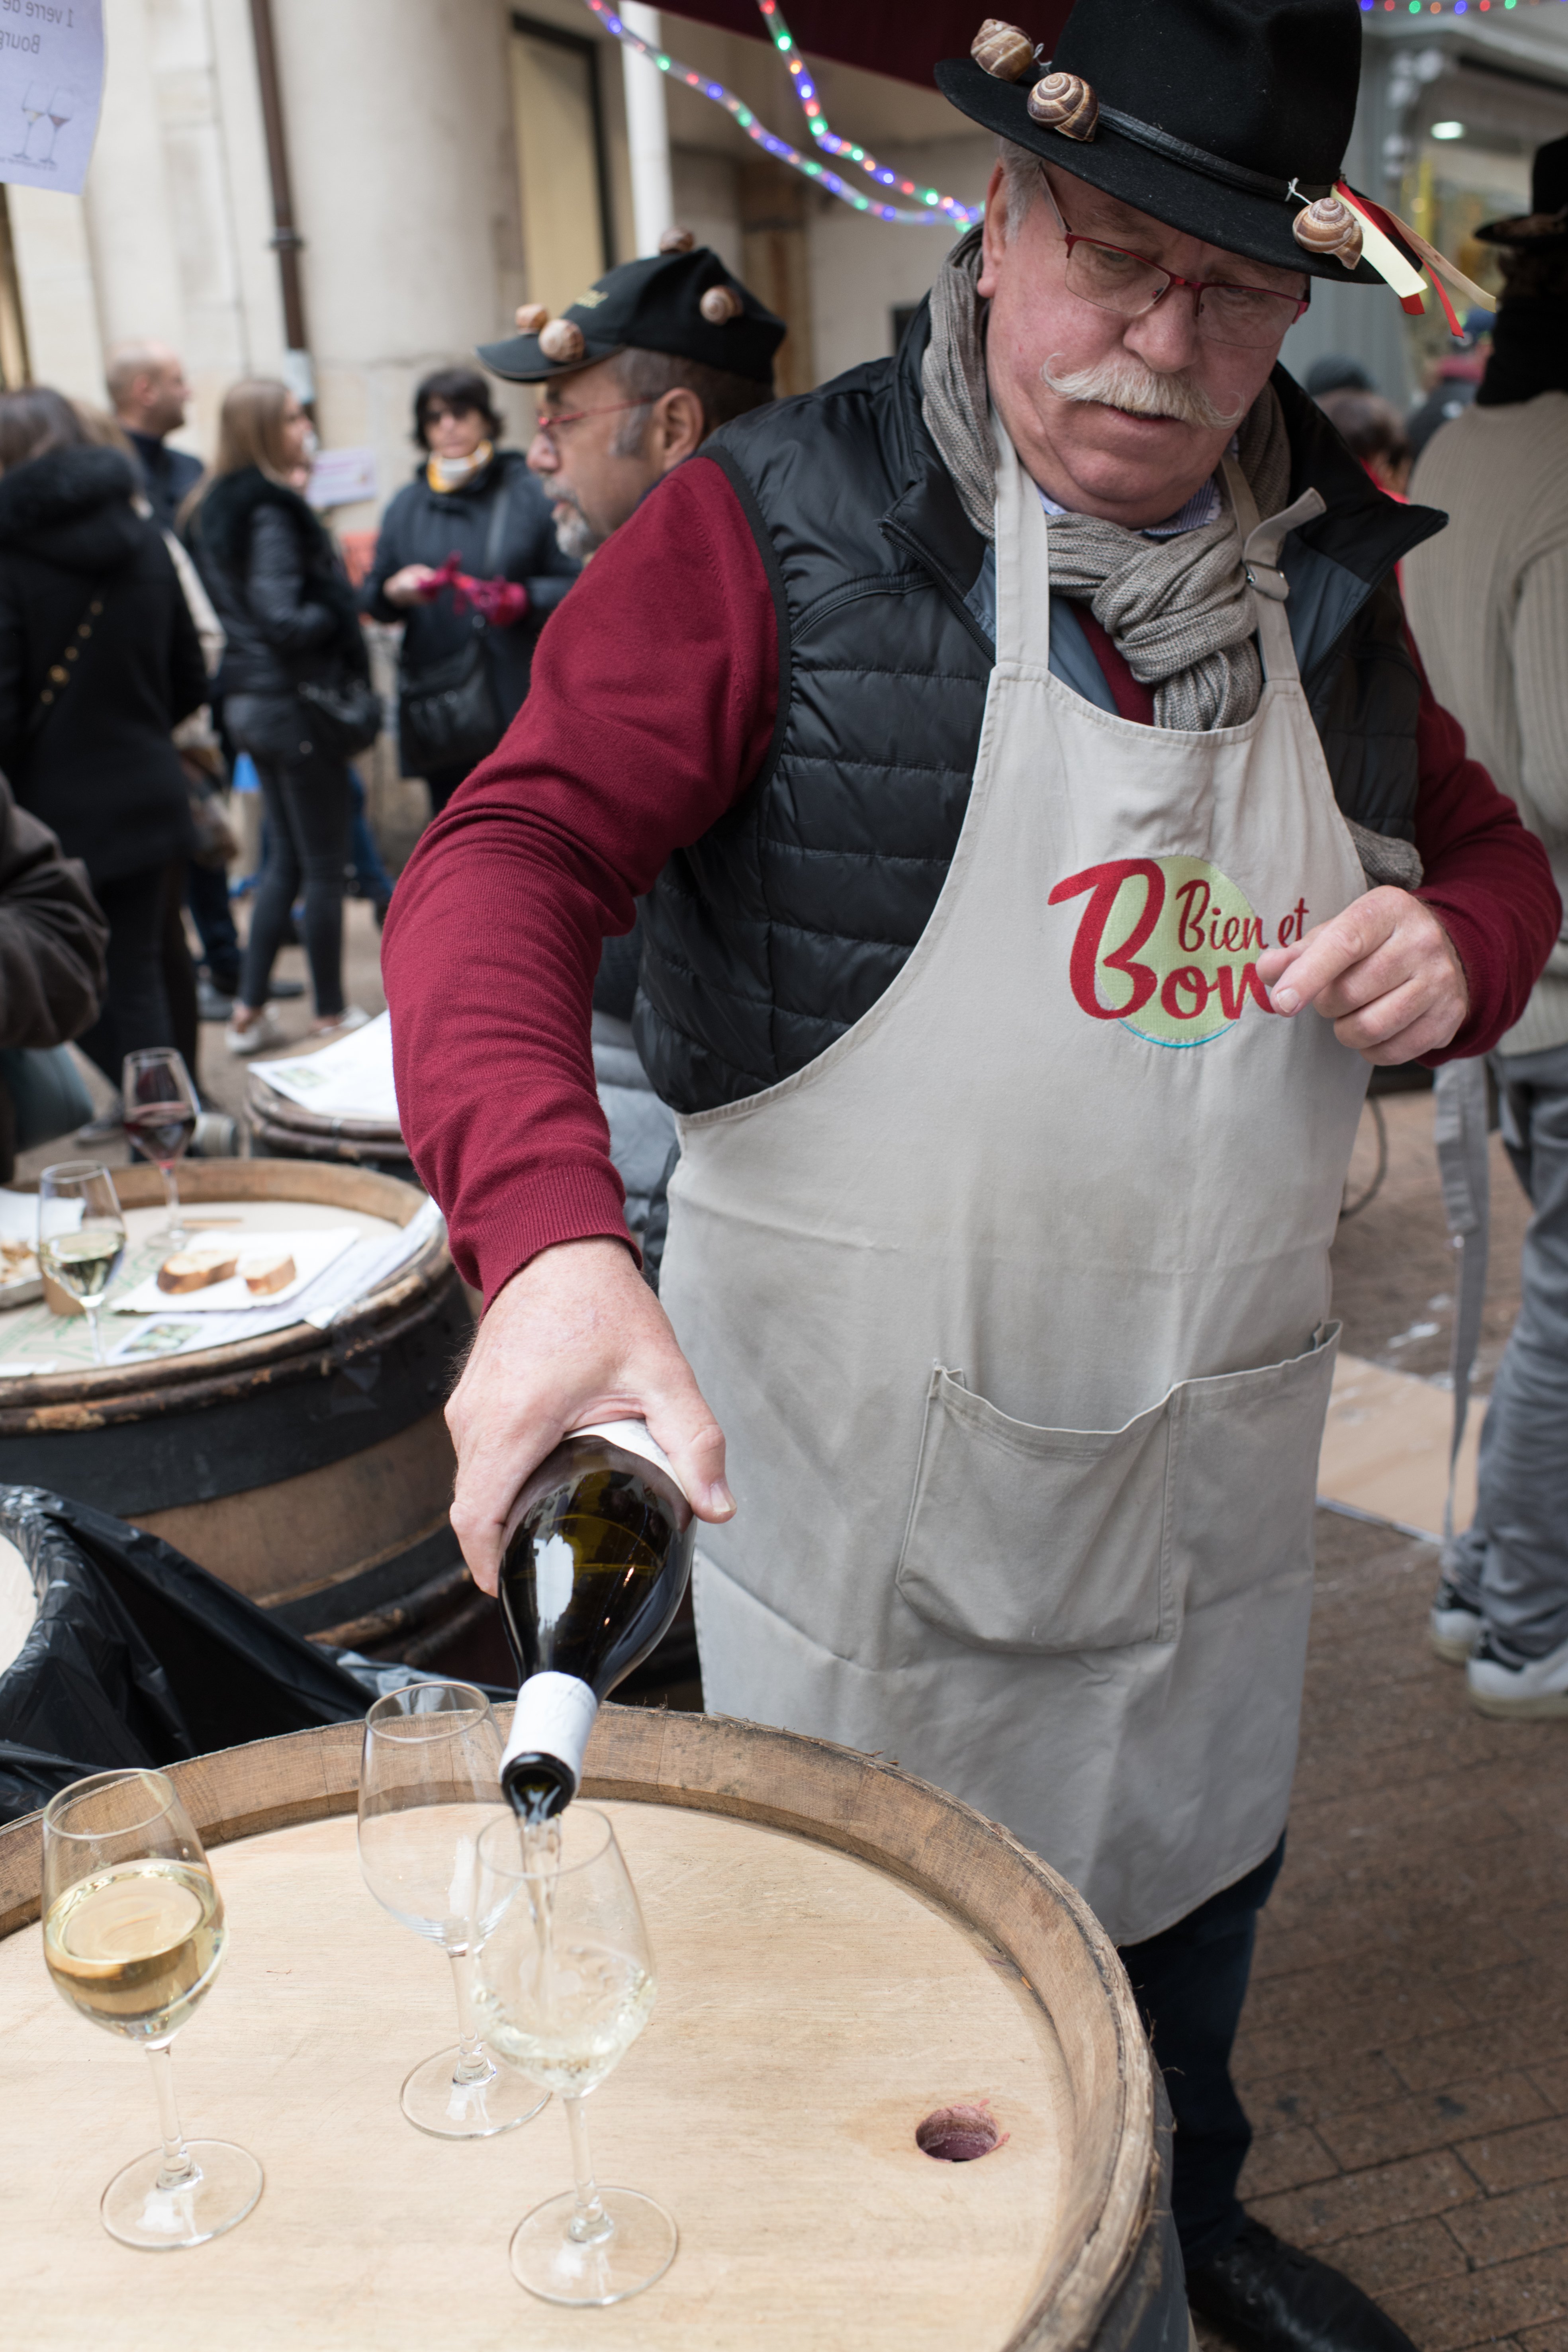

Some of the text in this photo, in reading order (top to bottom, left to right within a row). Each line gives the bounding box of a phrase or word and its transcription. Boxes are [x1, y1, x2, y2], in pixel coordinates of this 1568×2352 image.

[1047, 858, 1277, 1020] Bon
[1175, 879, 1310, 953] Bien et
